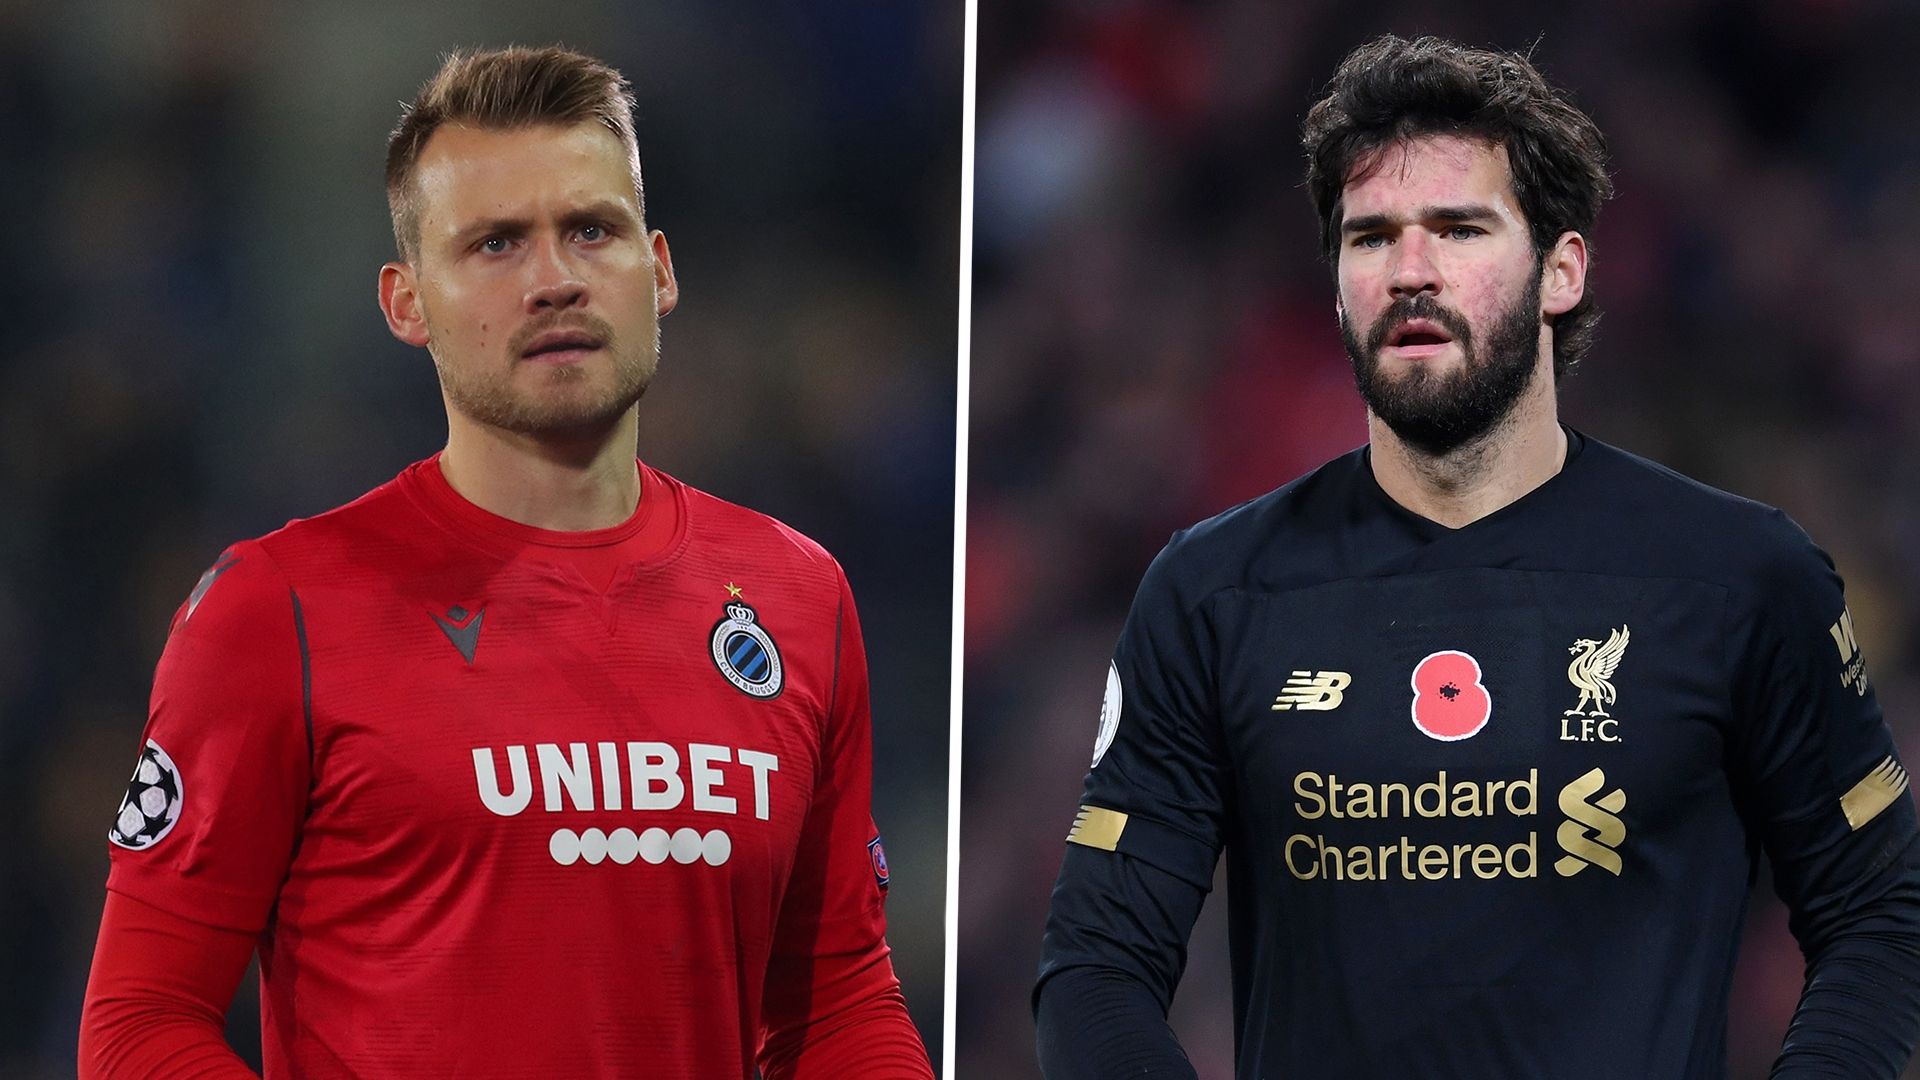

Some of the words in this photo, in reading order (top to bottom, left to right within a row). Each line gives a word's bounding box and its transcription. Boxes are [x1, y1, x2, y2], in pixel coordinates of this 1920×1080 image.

[720, 661, 741, 684] CLUB
[742, 682, 775, 695] BRUGGE
[1560, 719, 1622, 742] L.F.C.
[471, 741, 779, 820] UNIBET
[1293, 768, 1538, 820] Standard
[1284, 831, 1537, 881] Chartered
